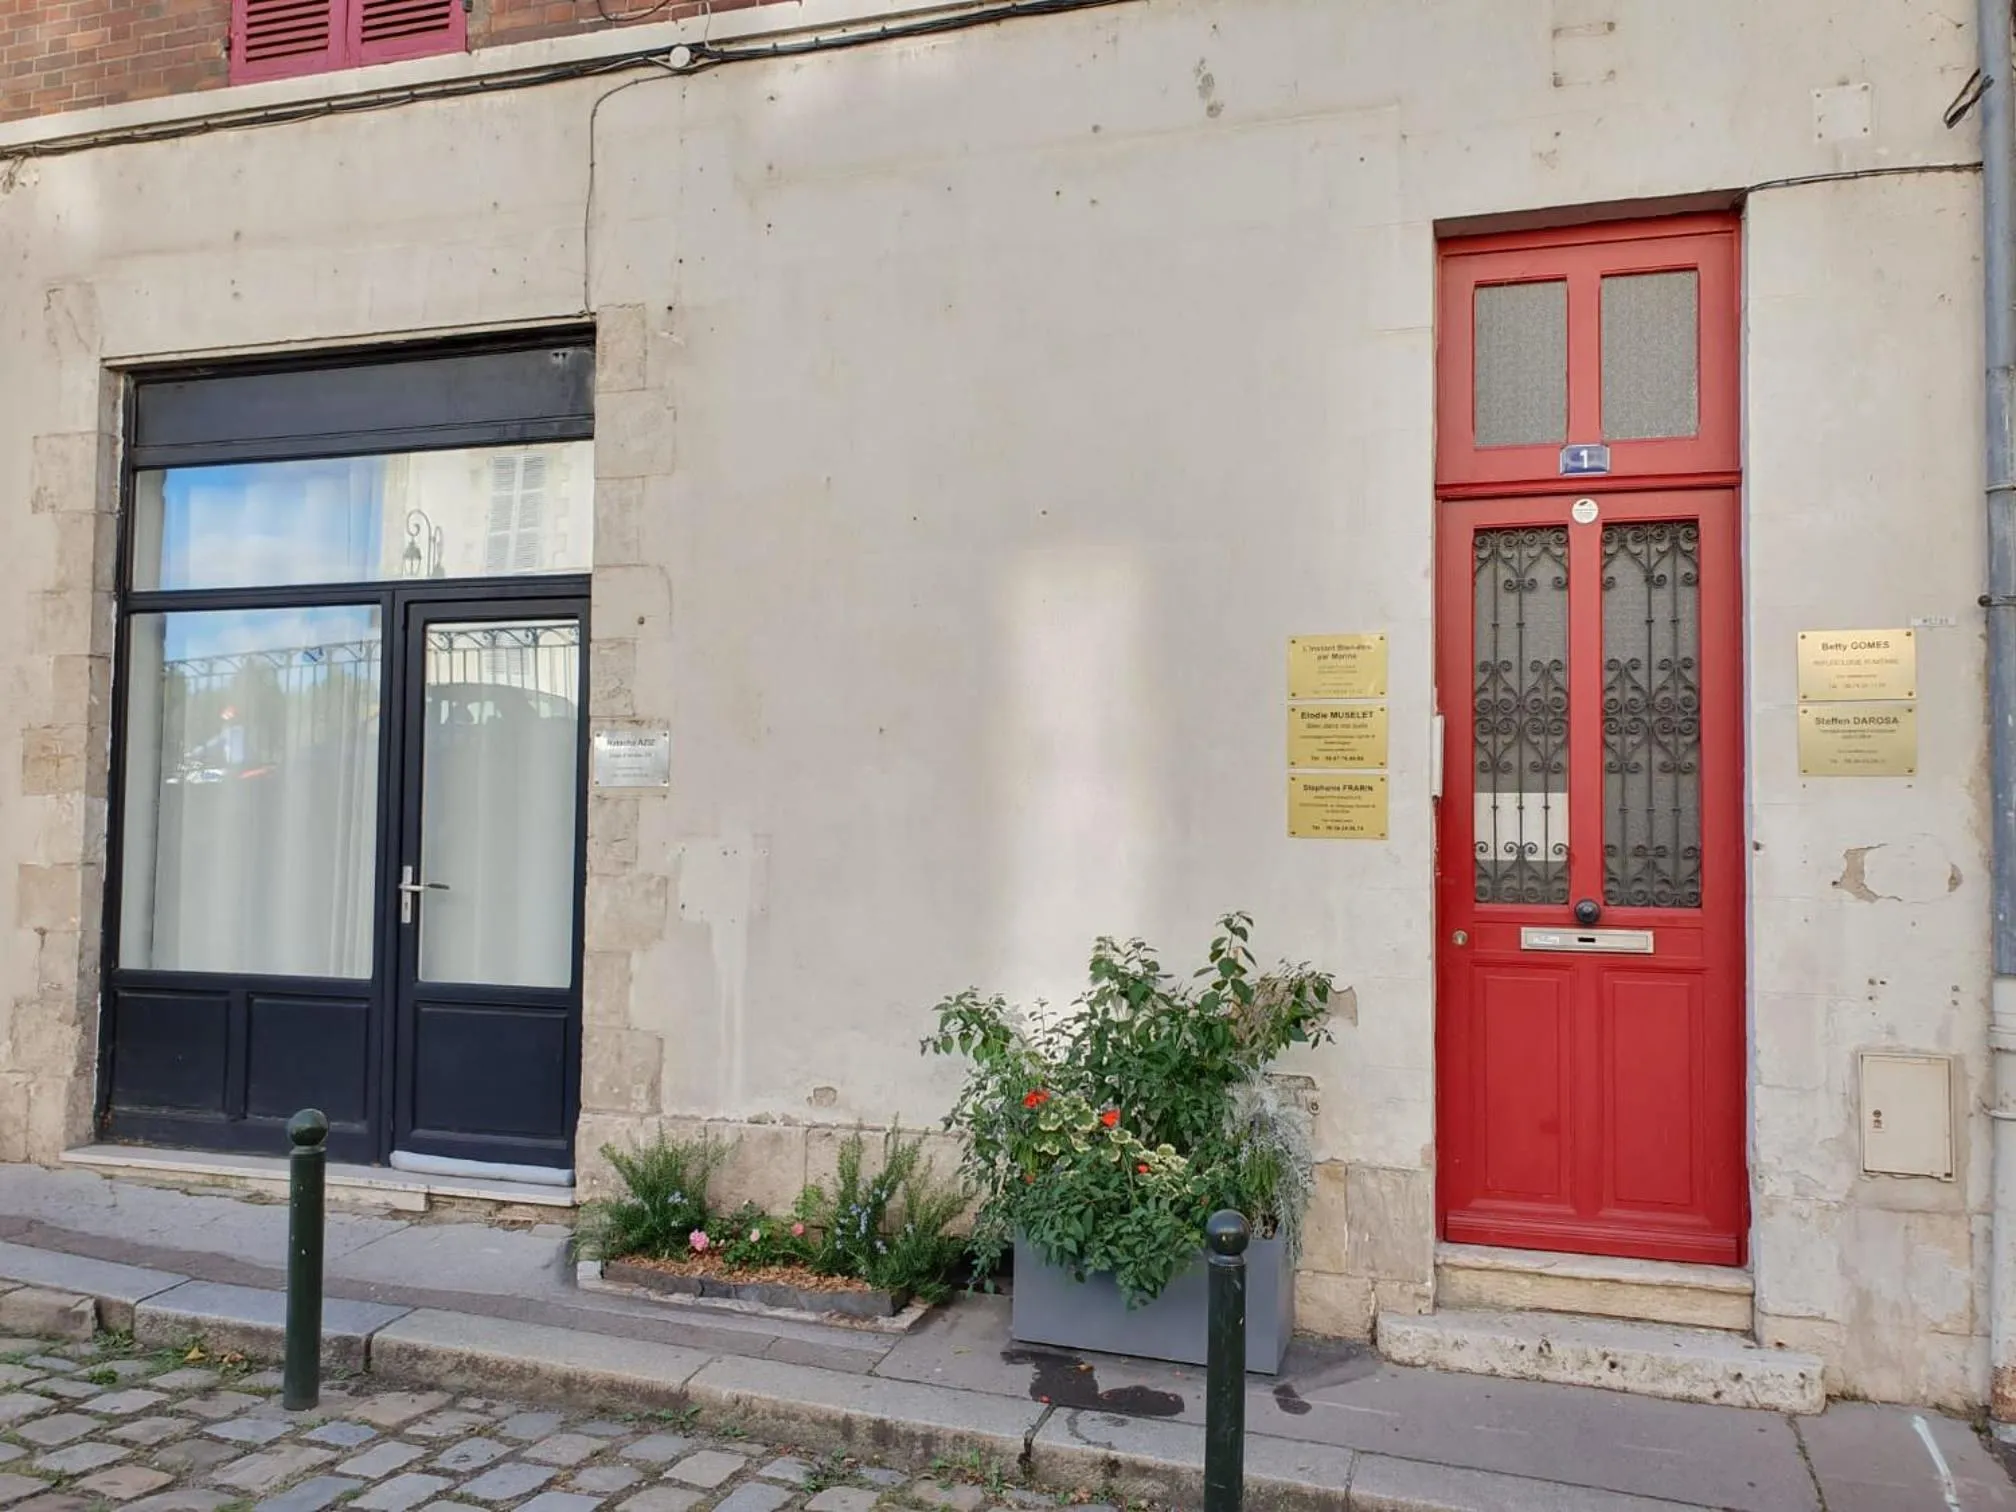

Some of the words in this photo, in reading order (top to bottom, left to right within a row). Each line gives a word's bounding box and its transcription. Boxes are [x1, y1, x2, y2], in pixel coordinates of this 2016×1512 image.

[1579, 449, 1589, 469] 1
[1821, 642, 1848, 652] Betty
[1850, 640, 1890, 650] GOMES
[1329, 710, 1374, 719] MUSELET
